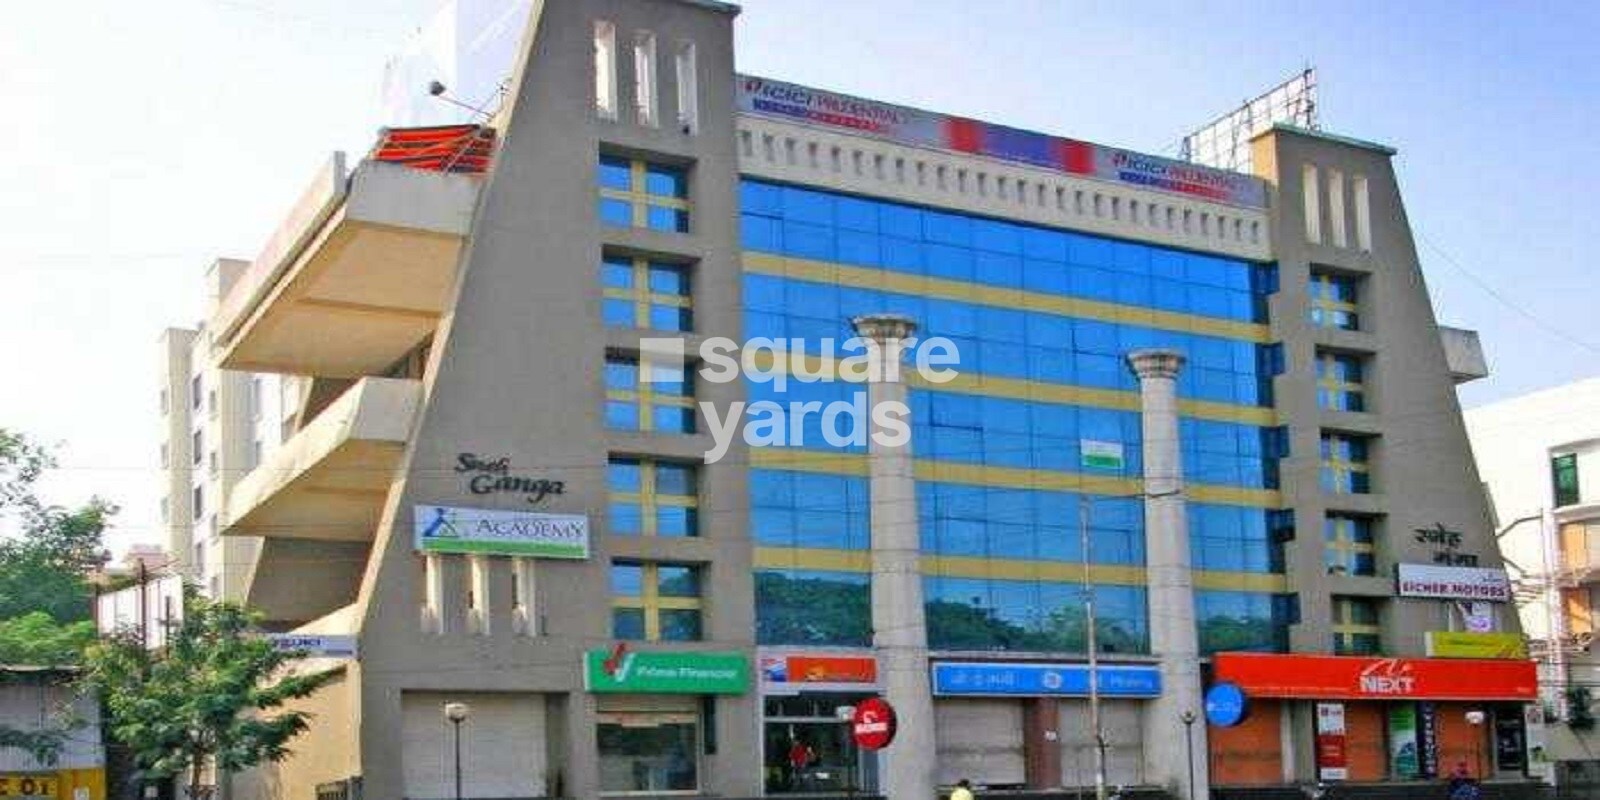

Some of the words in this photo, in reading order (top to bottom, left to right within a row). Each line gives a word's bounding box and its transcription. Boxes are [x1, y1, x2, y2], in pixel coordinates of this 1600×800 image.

[470, 474, 566, 503] Ganga
[1402, 581, 1448, 595] EICHER
[1451, 584, 1506, 598] MOTORS
[1360, 675, 1415, 693] NEXT
